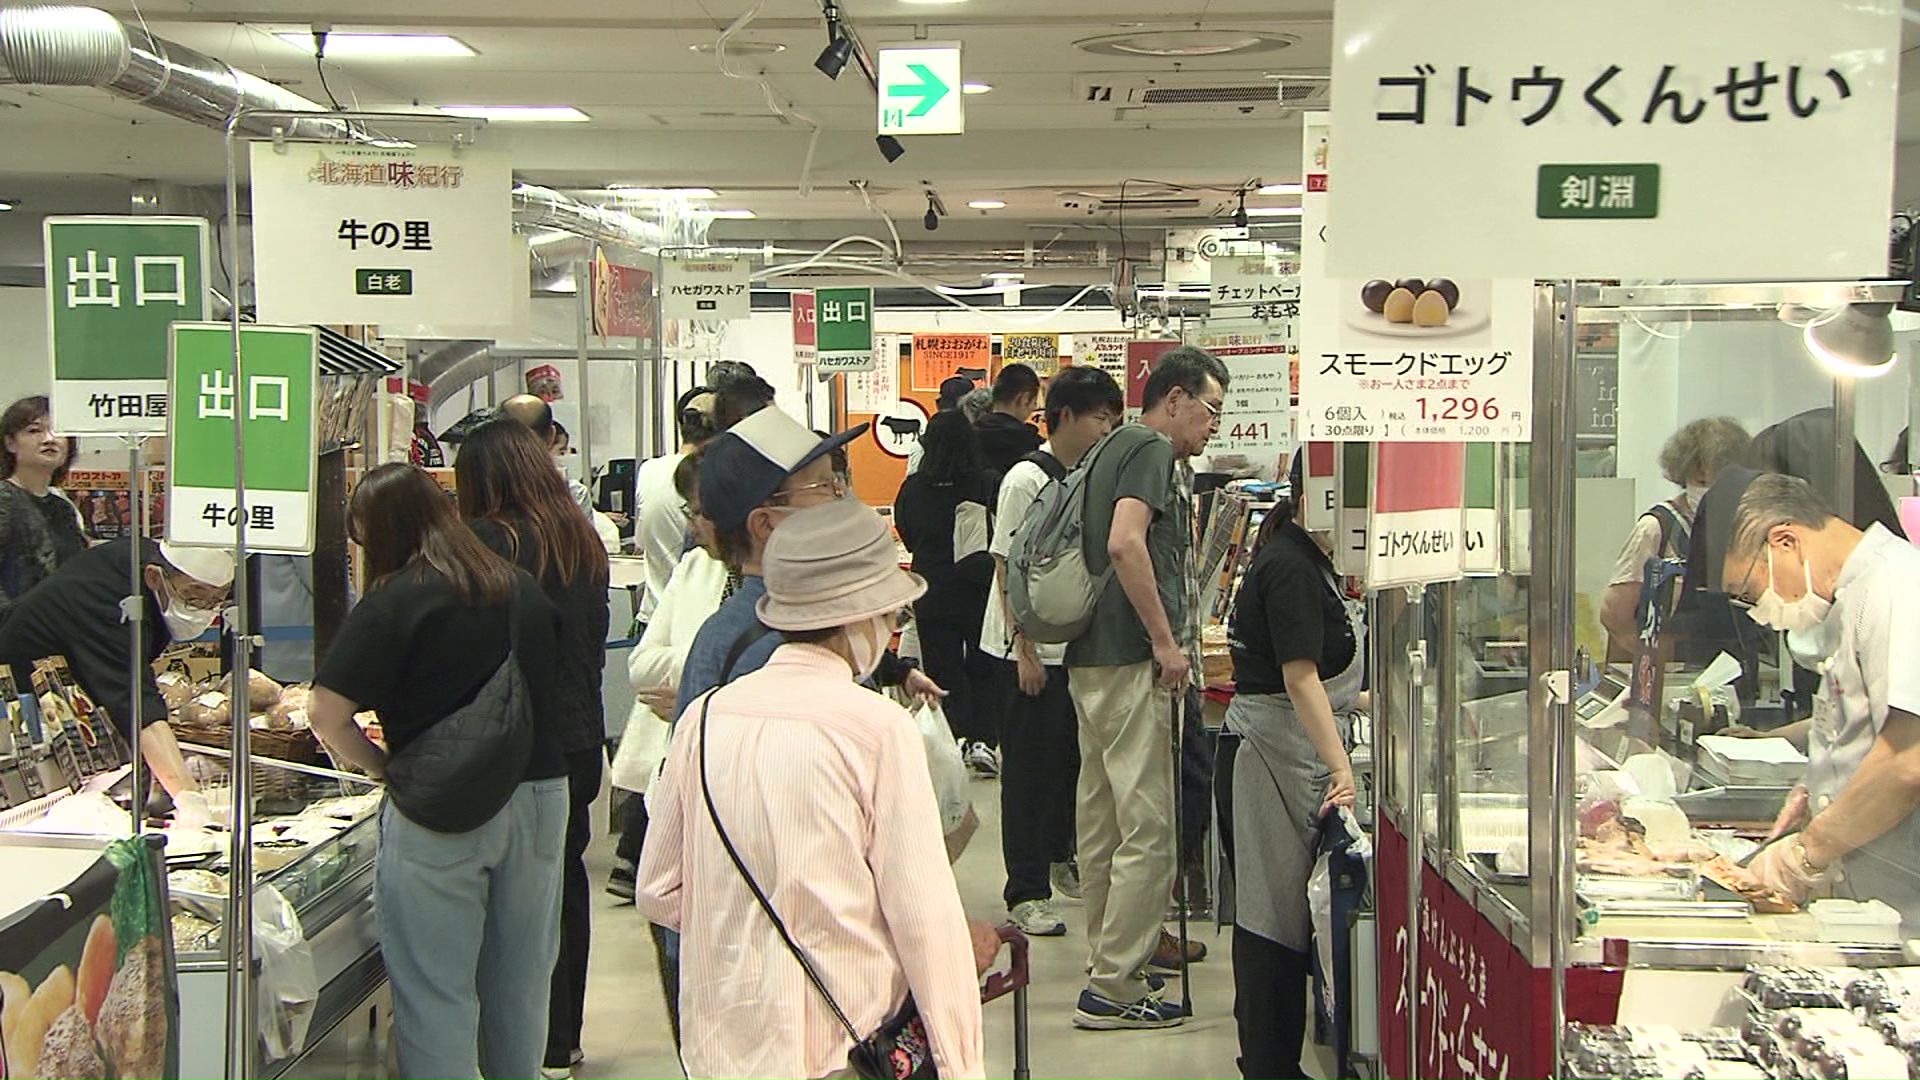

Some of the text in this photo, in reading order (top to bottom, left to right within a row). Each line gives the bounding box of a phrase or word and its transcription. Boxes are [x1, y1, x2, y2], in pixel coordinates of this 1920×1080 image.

[1376, 61, 1851, 127] ゴトウくんせい
[319, 161, 463, 188] 北海道味紀行
[1560, 174, 1636, 209] 剣淵
[338, 219, 432, 251] 牛の里
[67, 249, 187, 308] 出口
[366, 273, 402, 291] 白老
[671, 284, 745, 296] ハセガワストア
[822, 301, 866, 323] 出口
[915, 338, 988, 350] 札幌おおがわ
[819, 356, 871, 367] ハセガワストア
[1319, 351, 1512, 376] スモークドエッグ
[198, 370, 290, 422] 出口
[1358, 378, 1471, 390] ※お一人さま2点まで
[87, 392, 168, 418] 竹田屋
[1415, 397, 1500, 422] 1,296
[1511, 411, 1521, 420] 円
[1230, 423, 1269, 440] 441
[1378, 529, 1454, 557] ゴトウくんせい
